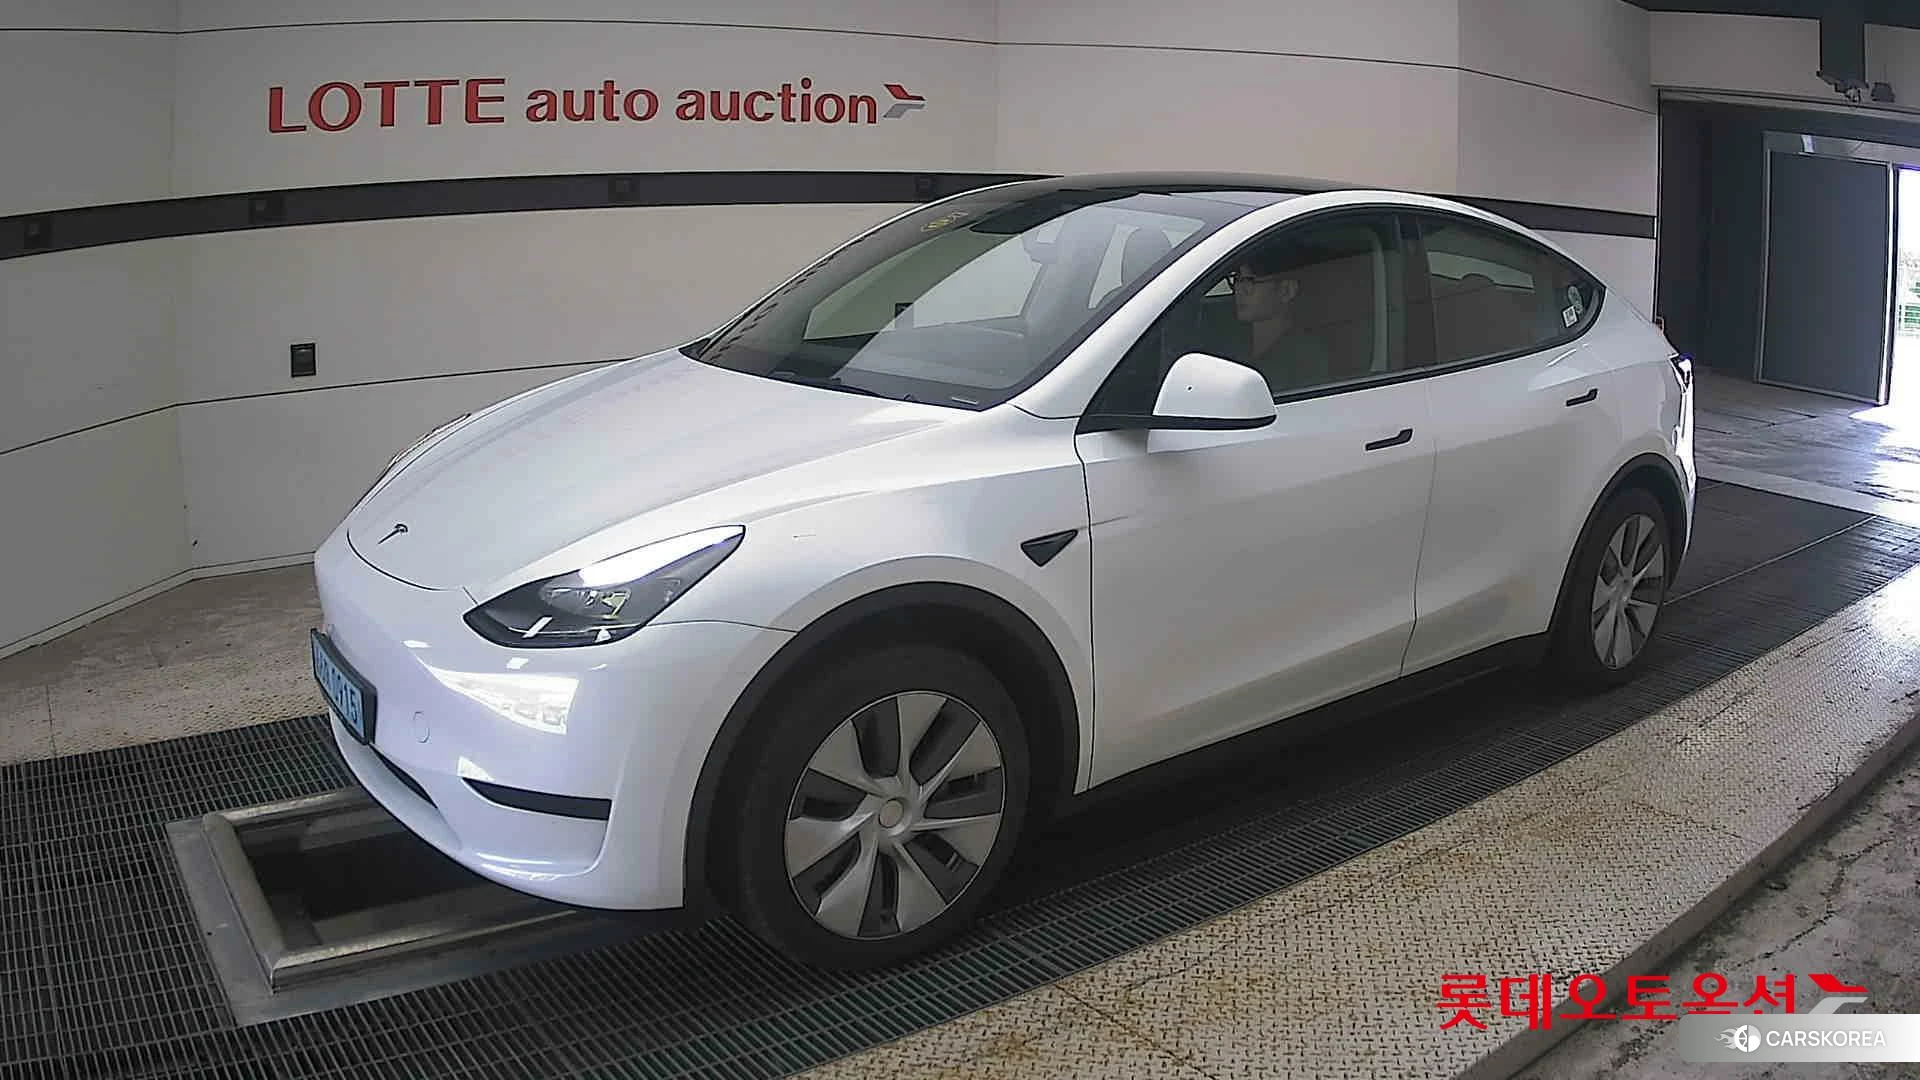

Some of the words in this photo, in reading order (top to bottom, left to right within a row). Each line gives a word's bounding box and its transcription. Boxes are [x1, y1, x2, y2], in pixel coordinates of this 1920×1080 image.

[268, 78, 505, 134] LOTTE
[526, 80, 659, 122] auto
[675, 78, 877, 124] auction
